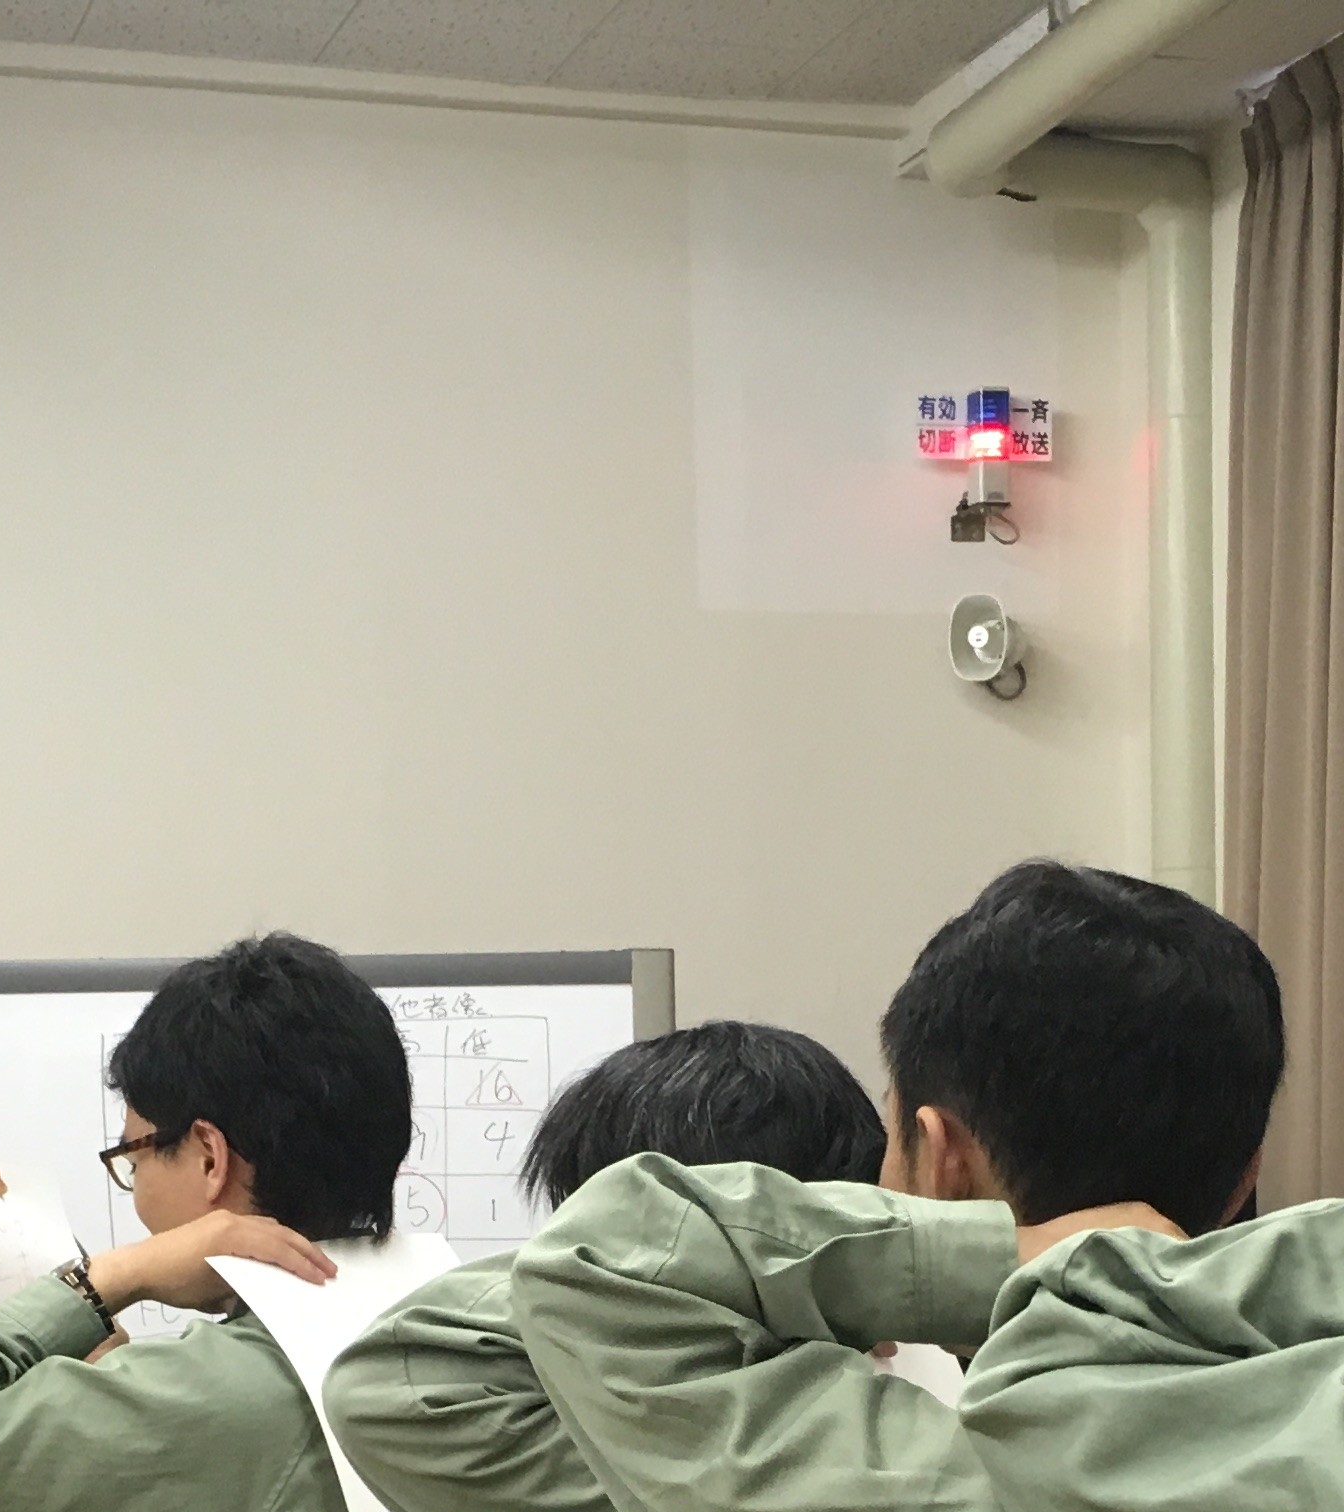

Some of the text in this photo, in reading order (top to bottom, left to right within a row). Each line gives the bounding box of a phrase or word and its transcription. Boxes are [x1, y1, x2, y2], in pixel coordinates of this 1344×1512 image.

[918, 396, 956, 421] 有効
[1012, 399, 1049, 423] 一斉
[918, 429, 956, 453] 切断
[1012, 431, 1049, 455] 放送
[484, 1121, 515, 1161] 4
[407, 1185, 429, 1227] 5
